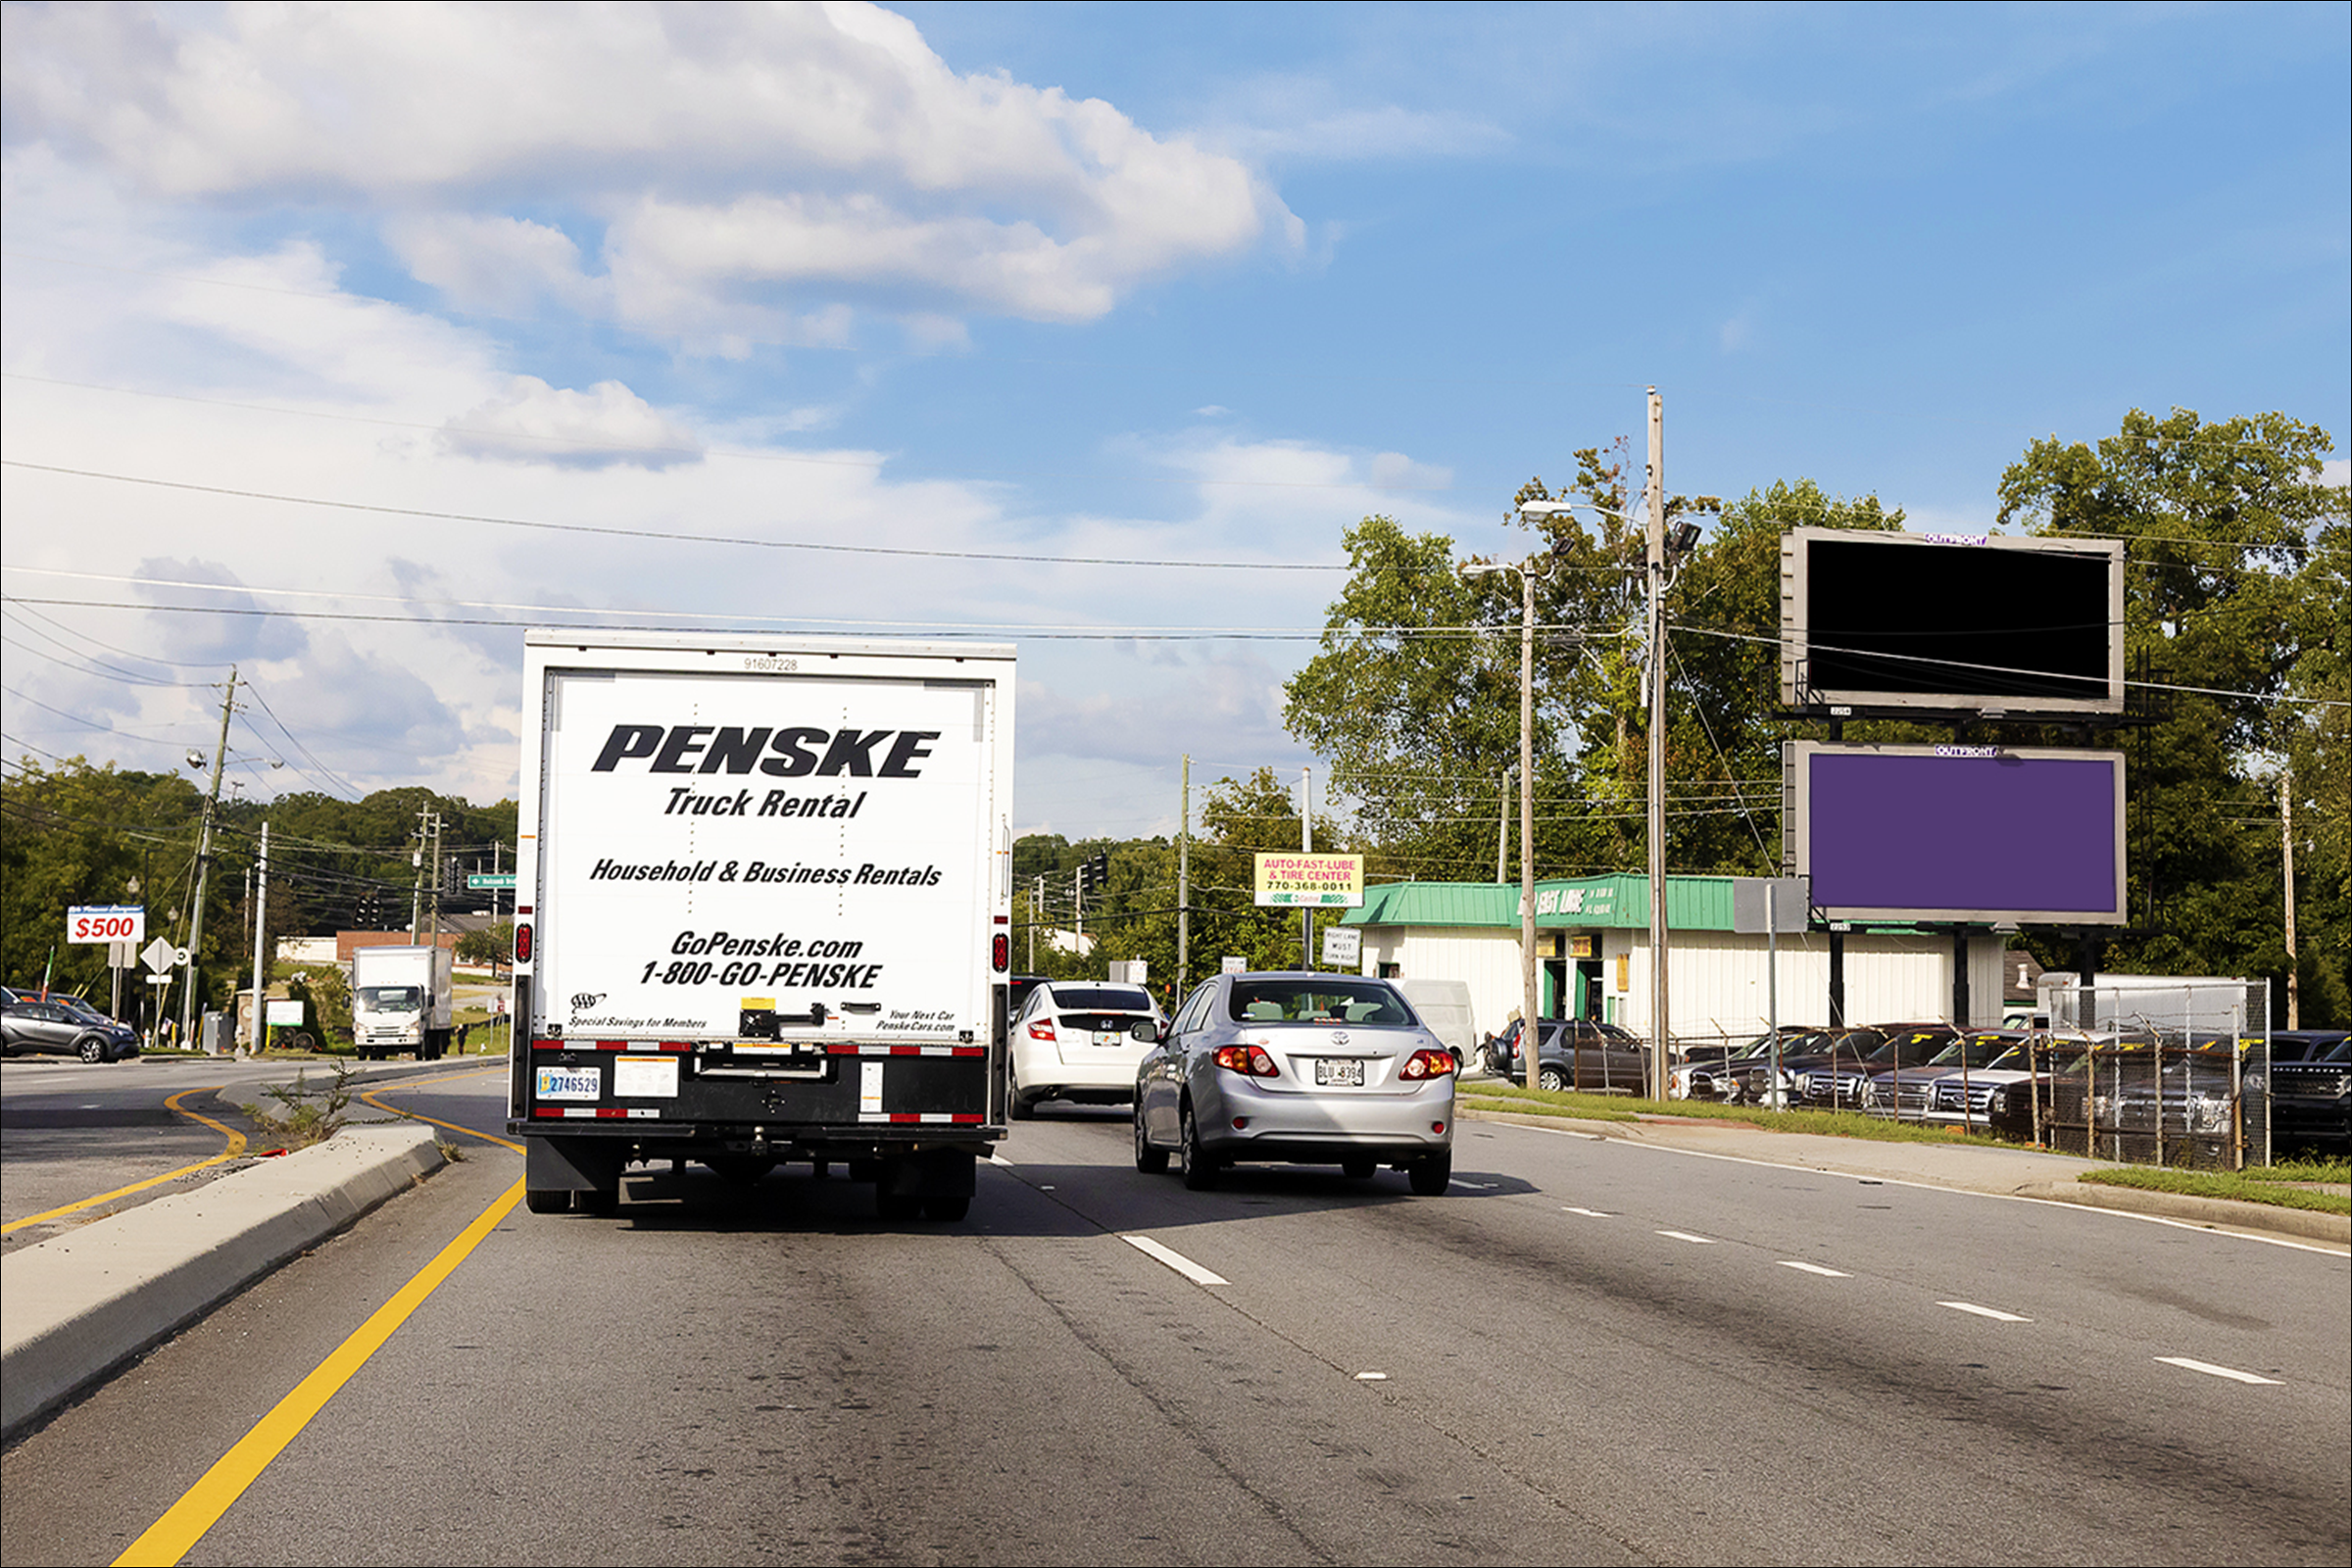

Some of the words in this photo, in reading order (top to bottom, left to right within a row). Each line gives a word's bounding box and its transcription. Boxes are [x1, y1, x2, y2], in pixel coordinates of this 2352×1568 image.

[744, 658, 798, 671] 91607228
[591, 724, 942, 778] PENSKE
[663, 787, 753, 816] Truck
[757, 789, 868, 819] Rental
[1263, 858, 1355, 870] AUTO-FAST-LUBE
[590, 858, 717, 882] Household
[718, 860, 738, 883] &
[743, 861, 852, 884] Business
[854, 863, 943, 887] Rentals
[1269, 870, 1277, 880] &
[1280, 870, 1304, 881] TIRE
[1306, 870, 1351, 881] CENTER
[1266, 881, 1351, 891] 770-368-0011
[75, 917, 134, 940] $500
[670, 930, 863, 958] GoPenske.com
[641, 960, 883, 989] 1-800-GO-PENSKE
[568, 1015, 607, 1027] Special
[607, 1016, 645, 1029] Savings
[646, 1017, 661, 1027] for
[662, 1017, 708, 1029] Members
[890, 1009, 910, 1019] Your
[911, 1010, 936, 1020] Next
[938, 1010, 955, 1020] Car
[875, 1020, 956, 1032] PenskeCars.com
[551, 1076, 598, 1093] 2746529
